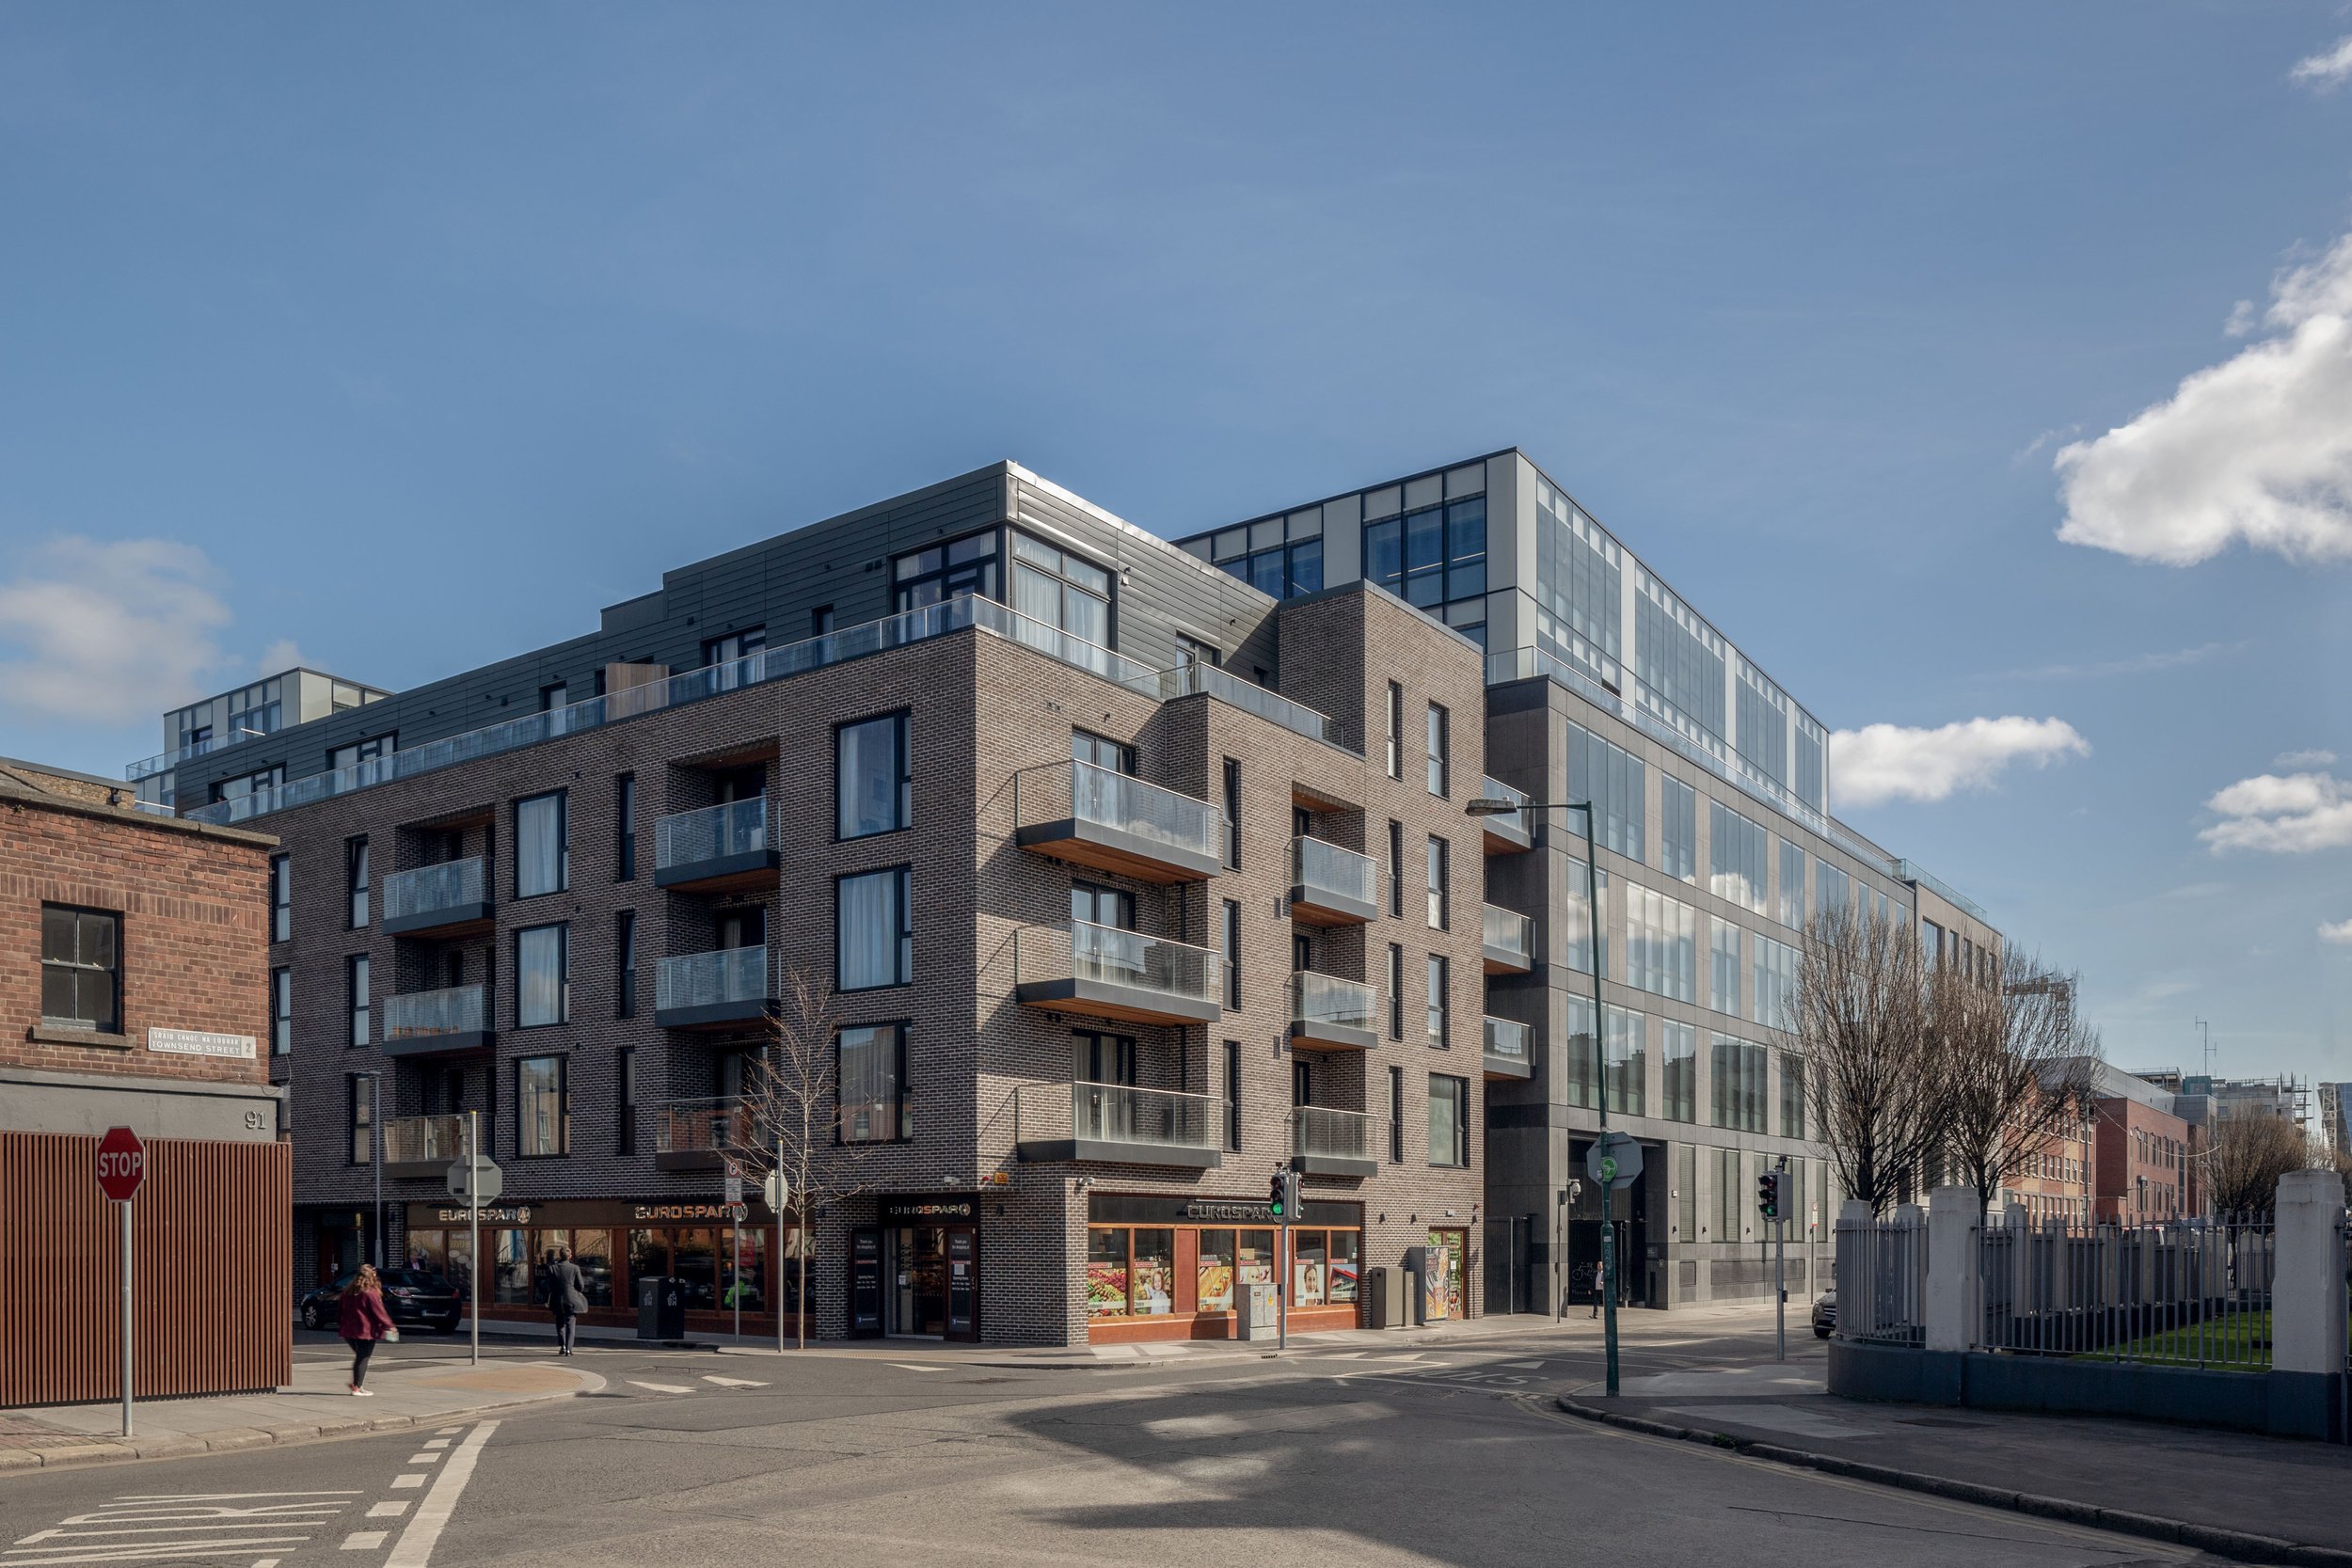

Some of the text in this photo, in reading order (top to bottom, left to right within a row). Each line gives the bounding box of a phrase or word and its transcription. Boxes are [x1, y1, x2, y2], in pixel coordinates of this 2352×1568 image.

[201, 1035, 210, 1043] NA
[151, 1040, 240, 1054] TOWNSEND STREET
[246, 1042, 251, 1053] 2
[245, 1110, 266, 1131] 91
[99, 1151, 142, 1178] STOP
